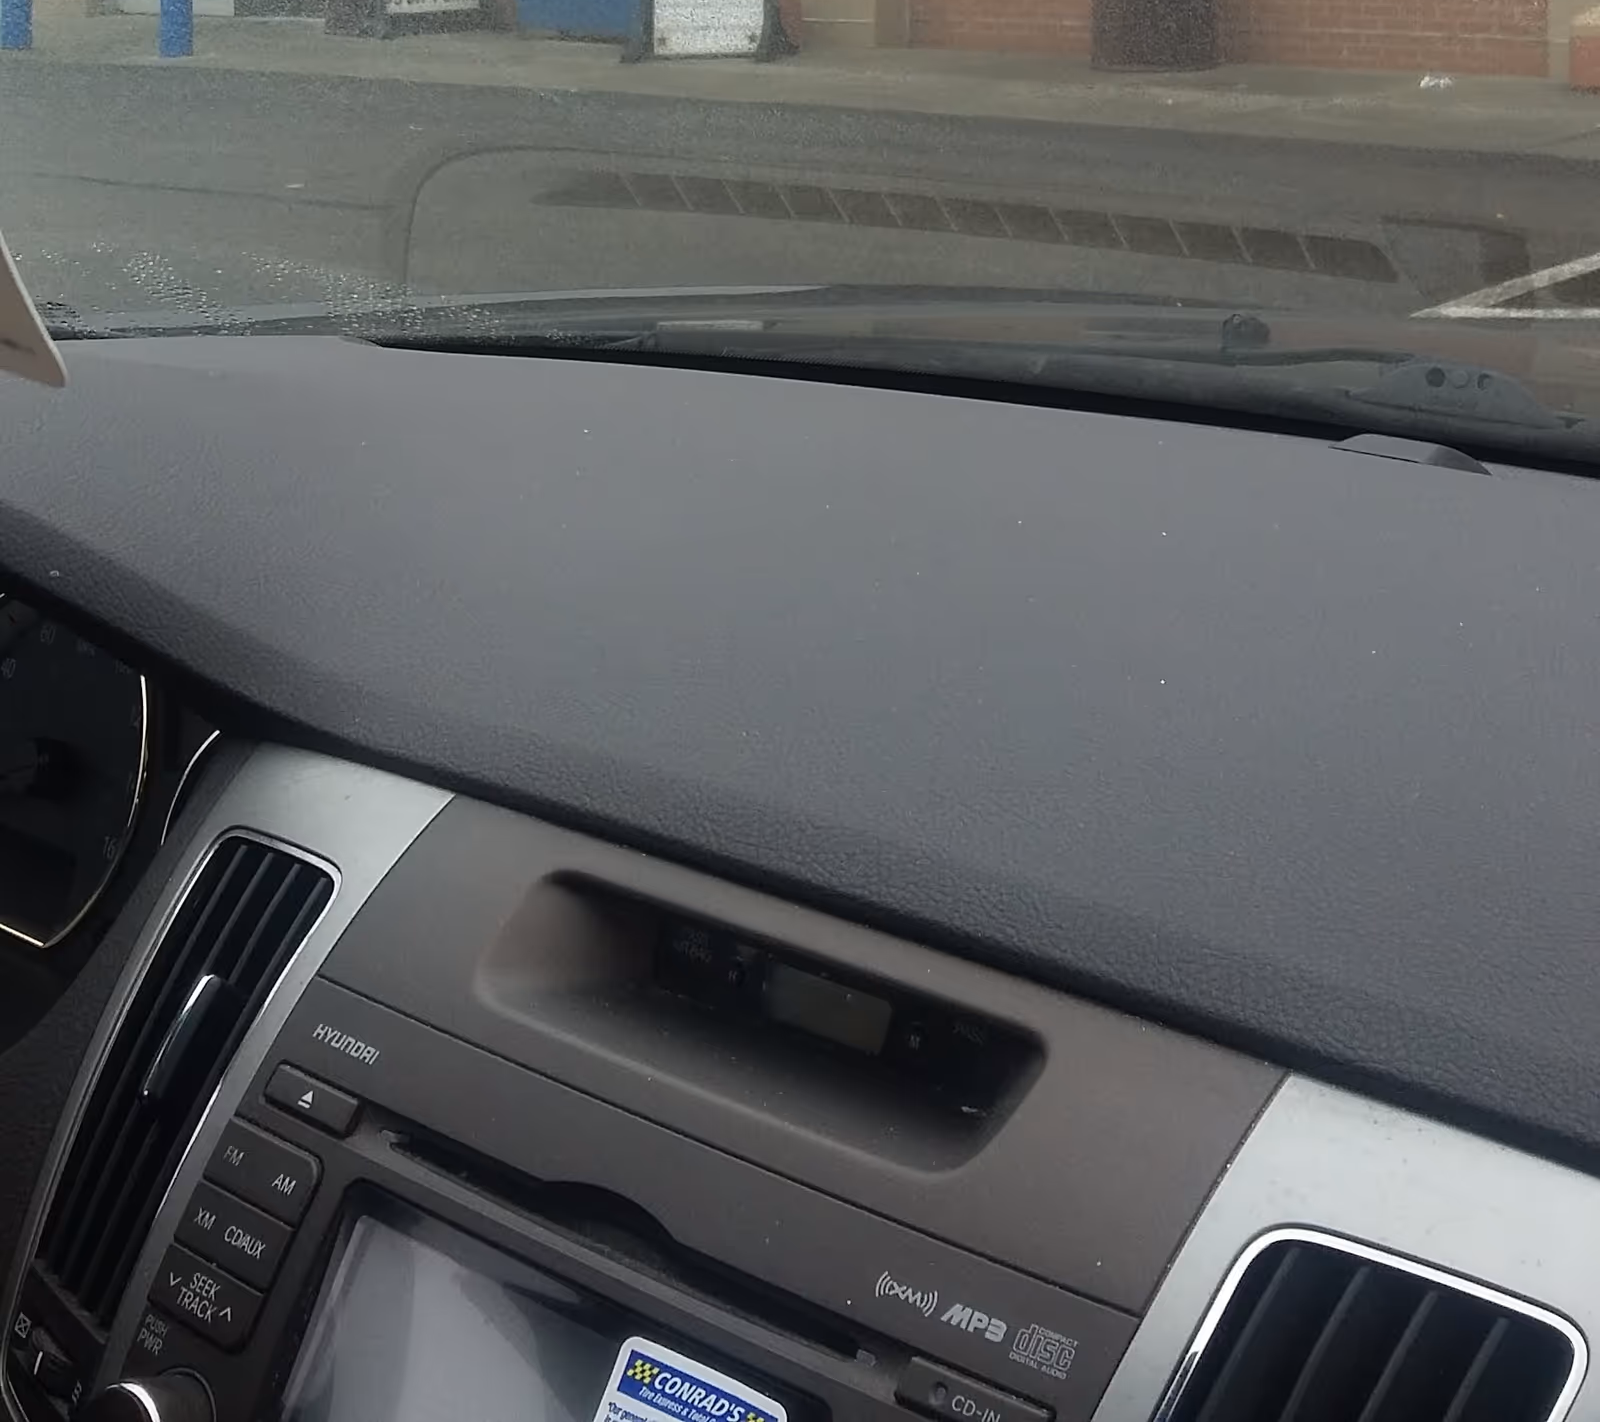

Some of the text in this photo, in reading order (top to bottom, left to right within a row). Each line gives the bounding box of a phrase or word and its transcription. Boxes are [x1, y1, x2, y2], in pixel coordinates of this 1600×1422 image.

[312, 1024, 380, 1065] HYUNDAI
[223, 1145, 296, 1196] FM AM
[193, 1207, 266, 1260] XM CD/AUX
[189, 1272, 221, 1302] SEEK
[176, 1287, 216, 1323] TRACK
[145, 1314, 168, 1337] PUSH
[940, 1303, 1007, 1343] MP3
[1039, 1326, 1080, 1348] COMPACT
[136, 1327, 163, 1356] PWR
[1008, 1350, 1068, 1380] DIGITAL AUDIO
[639, 1385, 655, 1401] Tire
[652, 1393, 684, 1415] Express
[654, 1372, 746, 1422] CONRAD'S
[951, 1394, 1001, 1422] CD-IN
